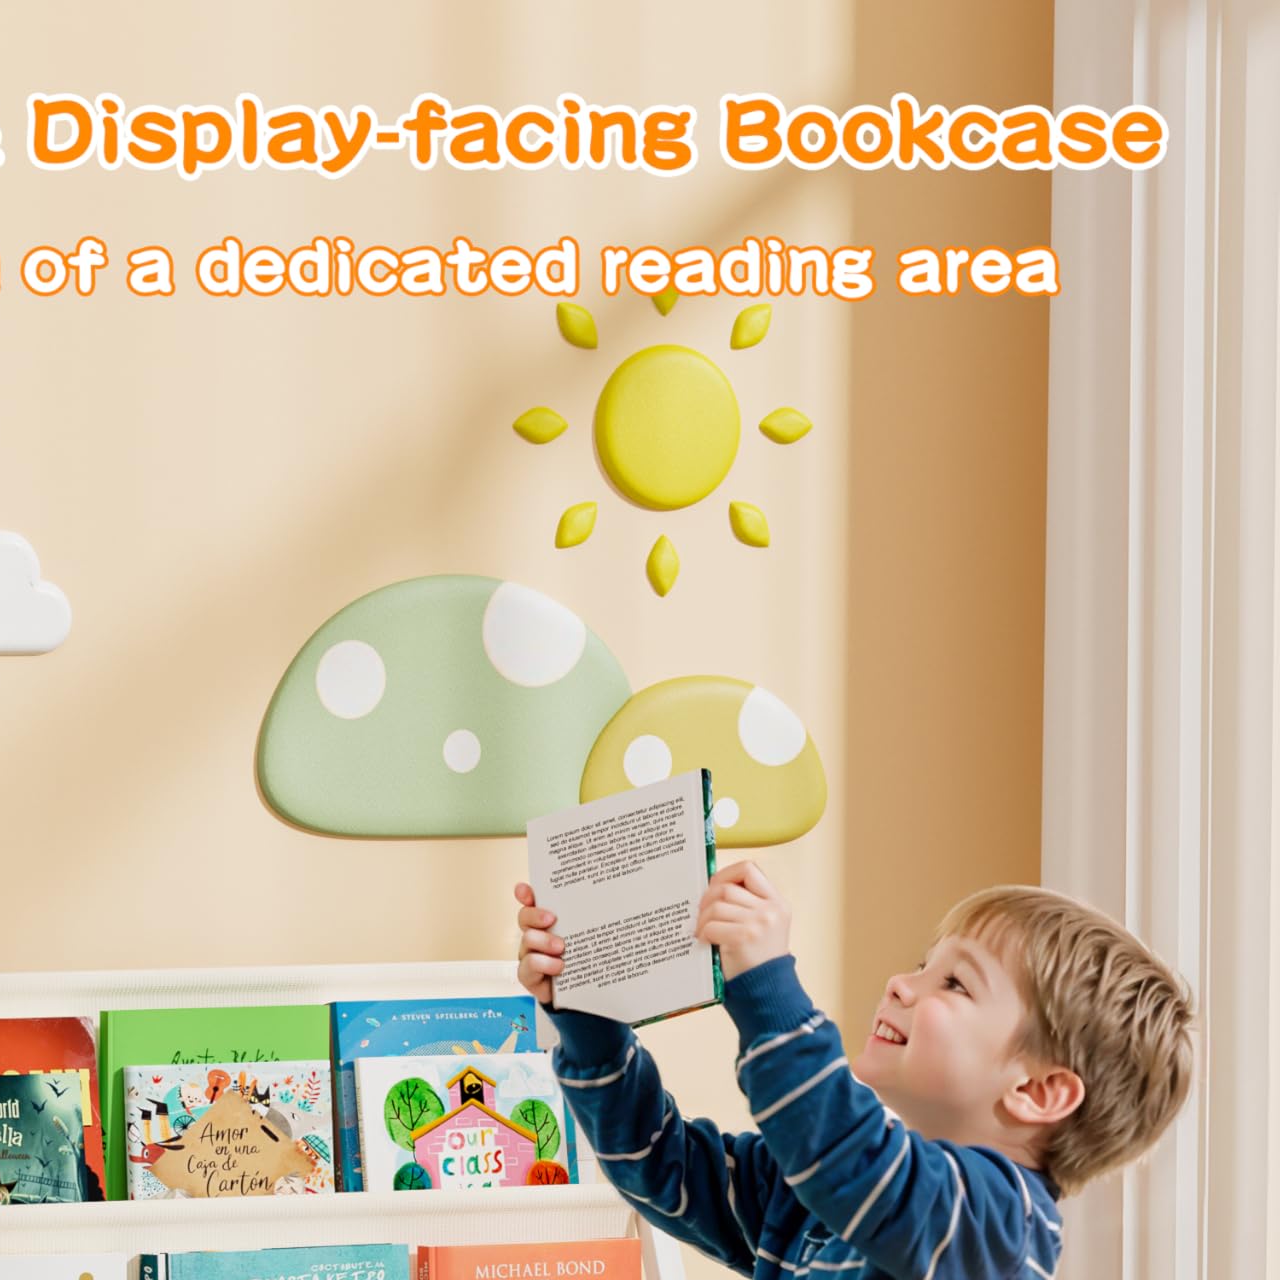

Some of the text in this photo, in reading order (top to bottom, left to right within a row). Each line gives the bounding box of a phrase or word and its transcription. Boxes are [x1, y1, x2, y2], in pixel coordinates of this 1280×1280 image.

[402, 1013, 431, 1021] STEVEN
[435, 1012, 479, 1020] SPIELBERG
[200, 1121, 249, 1146] Amor
[448, 1130, 494, 1150] our
[215, 1144, 260, 1155] en una
[187, 1154, 238, 1176] Caja de
[442, 1150, 503, 1176] class
[207, 1166, 273, 1197] Cartón
[475, 1260, 606, 1280] MICHAEL BOND
